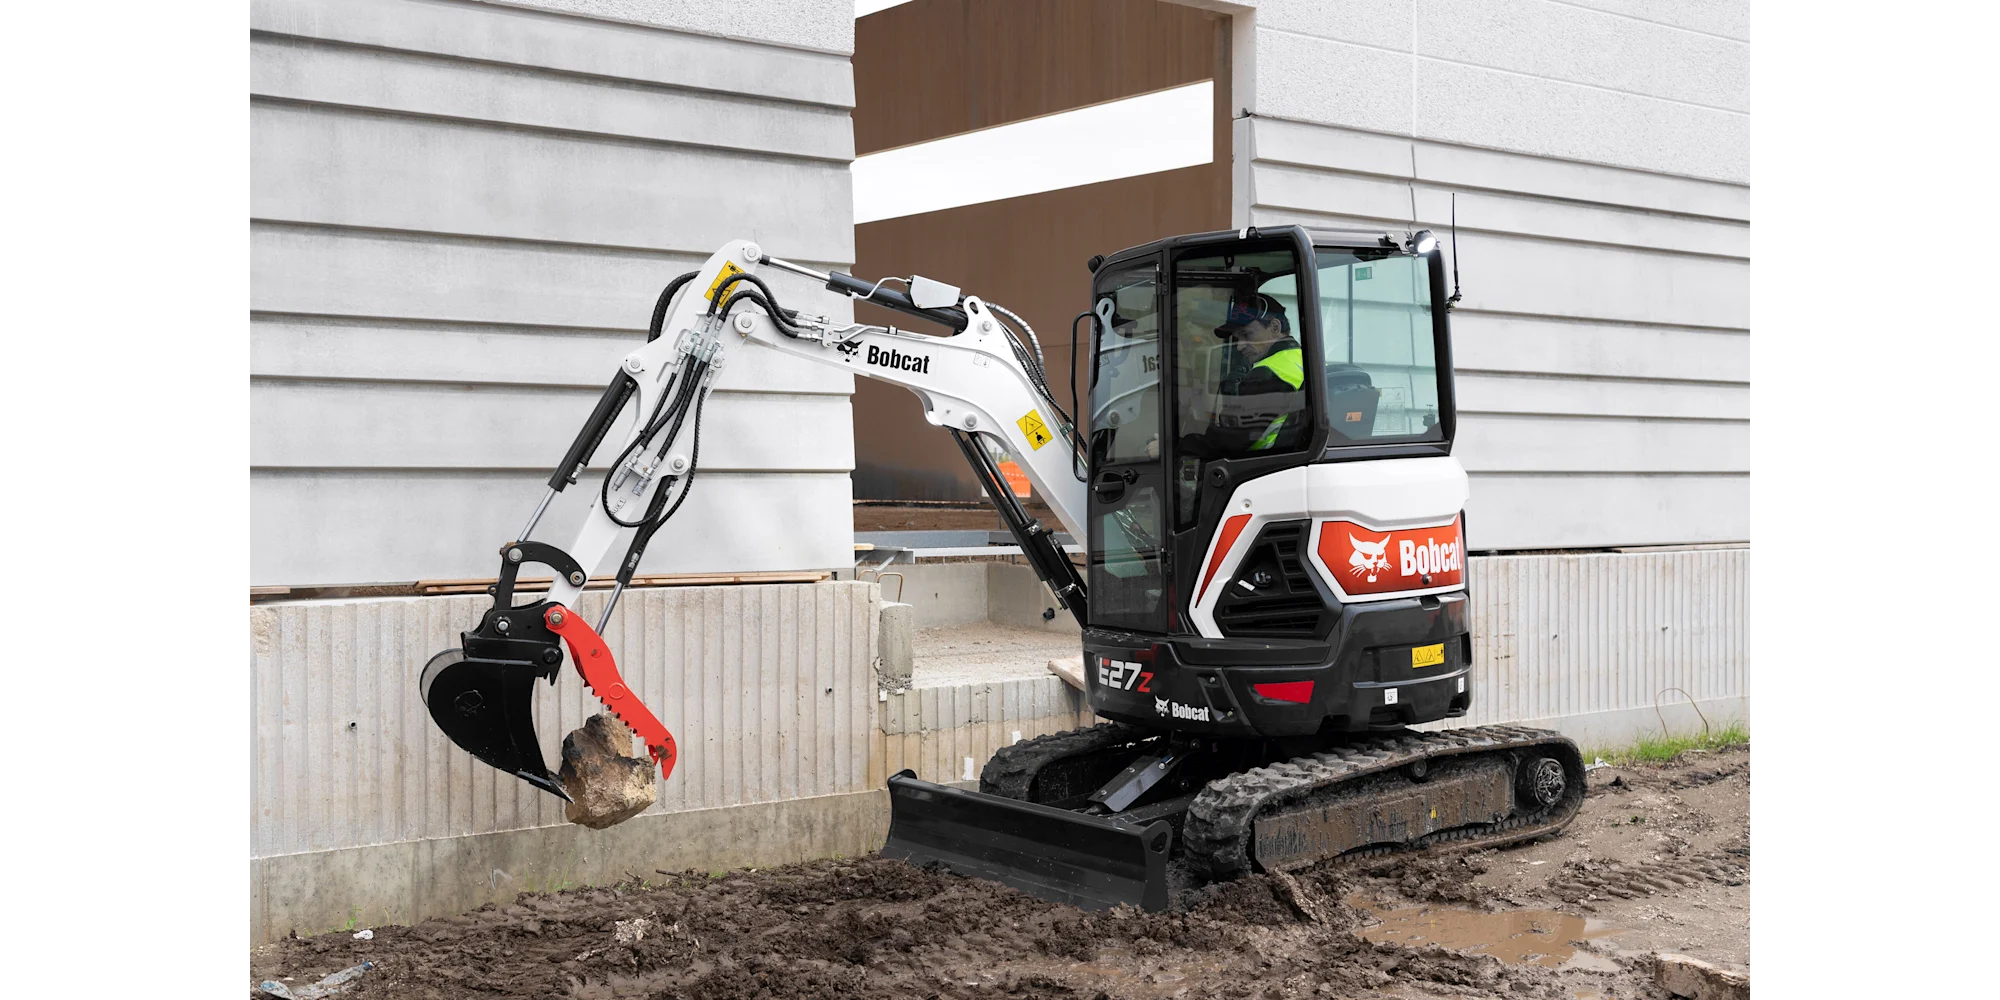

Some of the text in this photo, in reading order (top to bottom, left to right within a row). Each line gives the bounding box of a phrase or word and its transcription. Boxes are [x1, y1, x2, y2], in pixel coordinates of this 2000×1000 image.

[867, 345, 930, 374] Bobcat
[1399, 537, 1461, 577] Bobcat
[1171, 702, 1210, 722] Bobcat
